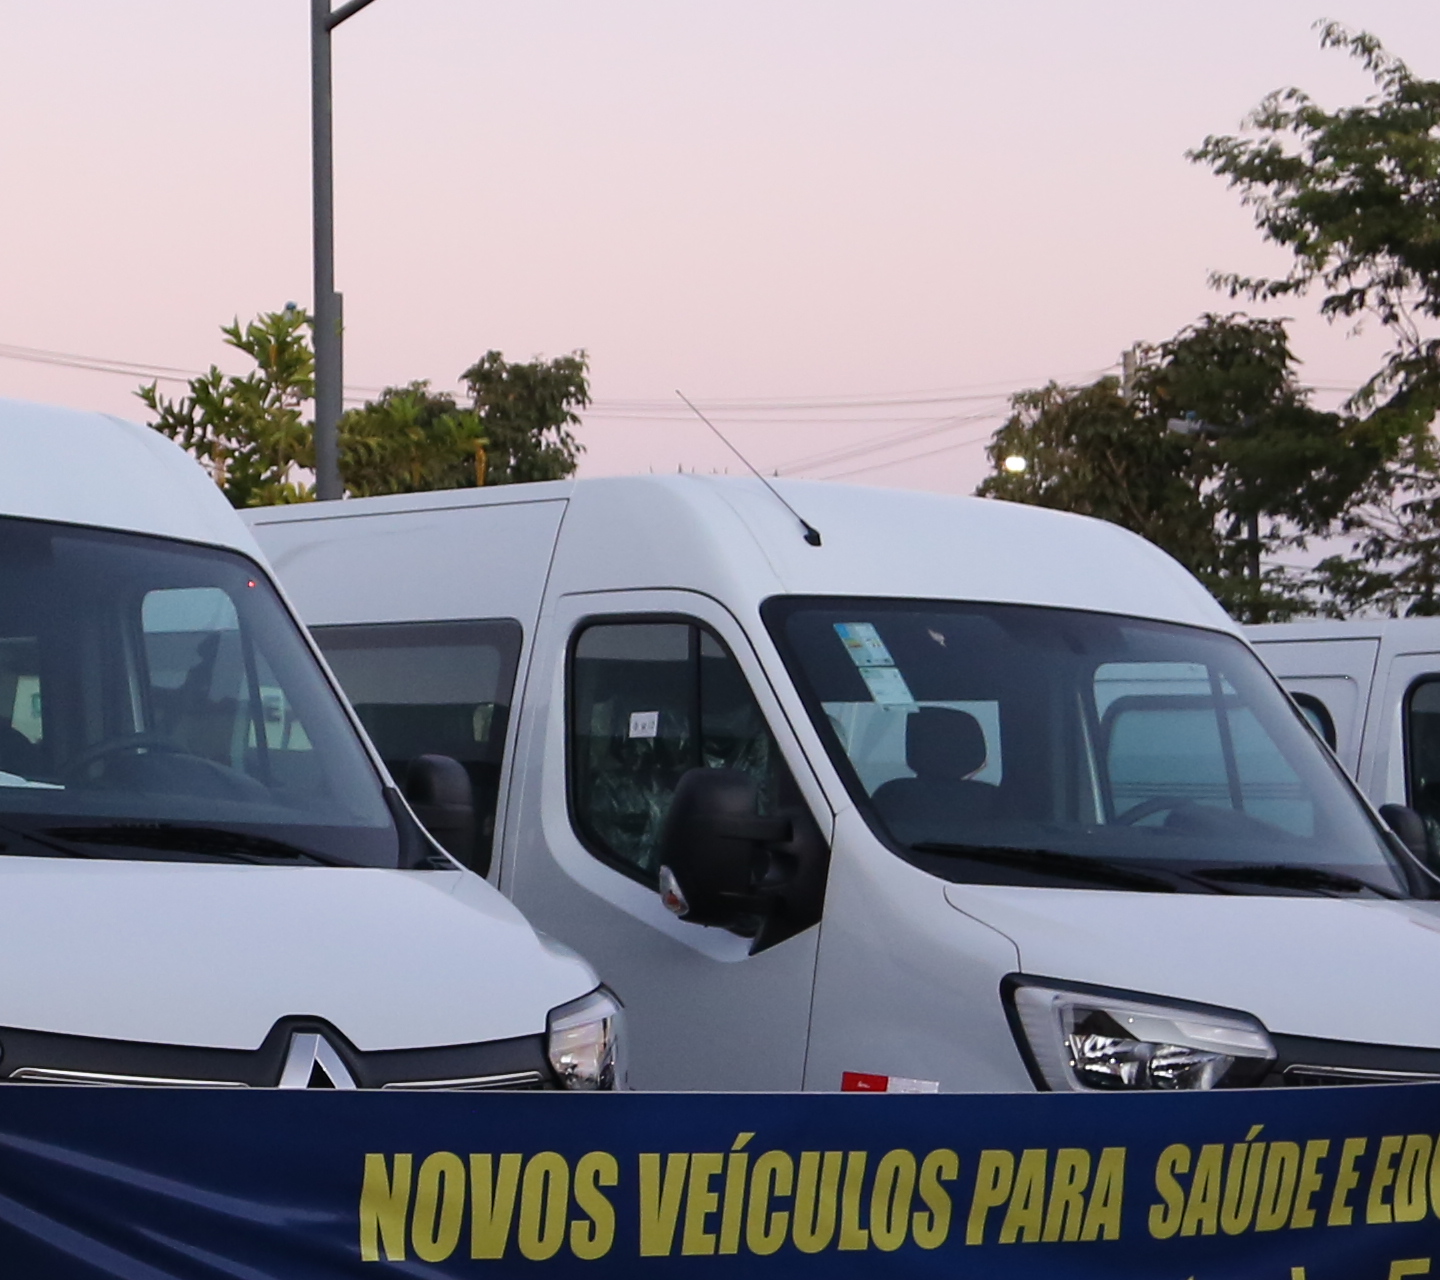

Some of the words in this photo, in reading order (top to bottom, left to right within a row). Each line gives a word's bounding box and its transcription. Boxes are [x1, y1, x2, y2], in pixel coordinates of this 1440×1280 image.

[358, 1150, 618, 1263] NOVOS
[638, 1131, 960, 1257] VEÍCULOS
[965, 1146, 1126, 1246] PARA
[1148, 1124, 1331, 1240] SAÚDE
[1326, 1137, 1367, 1227] E
